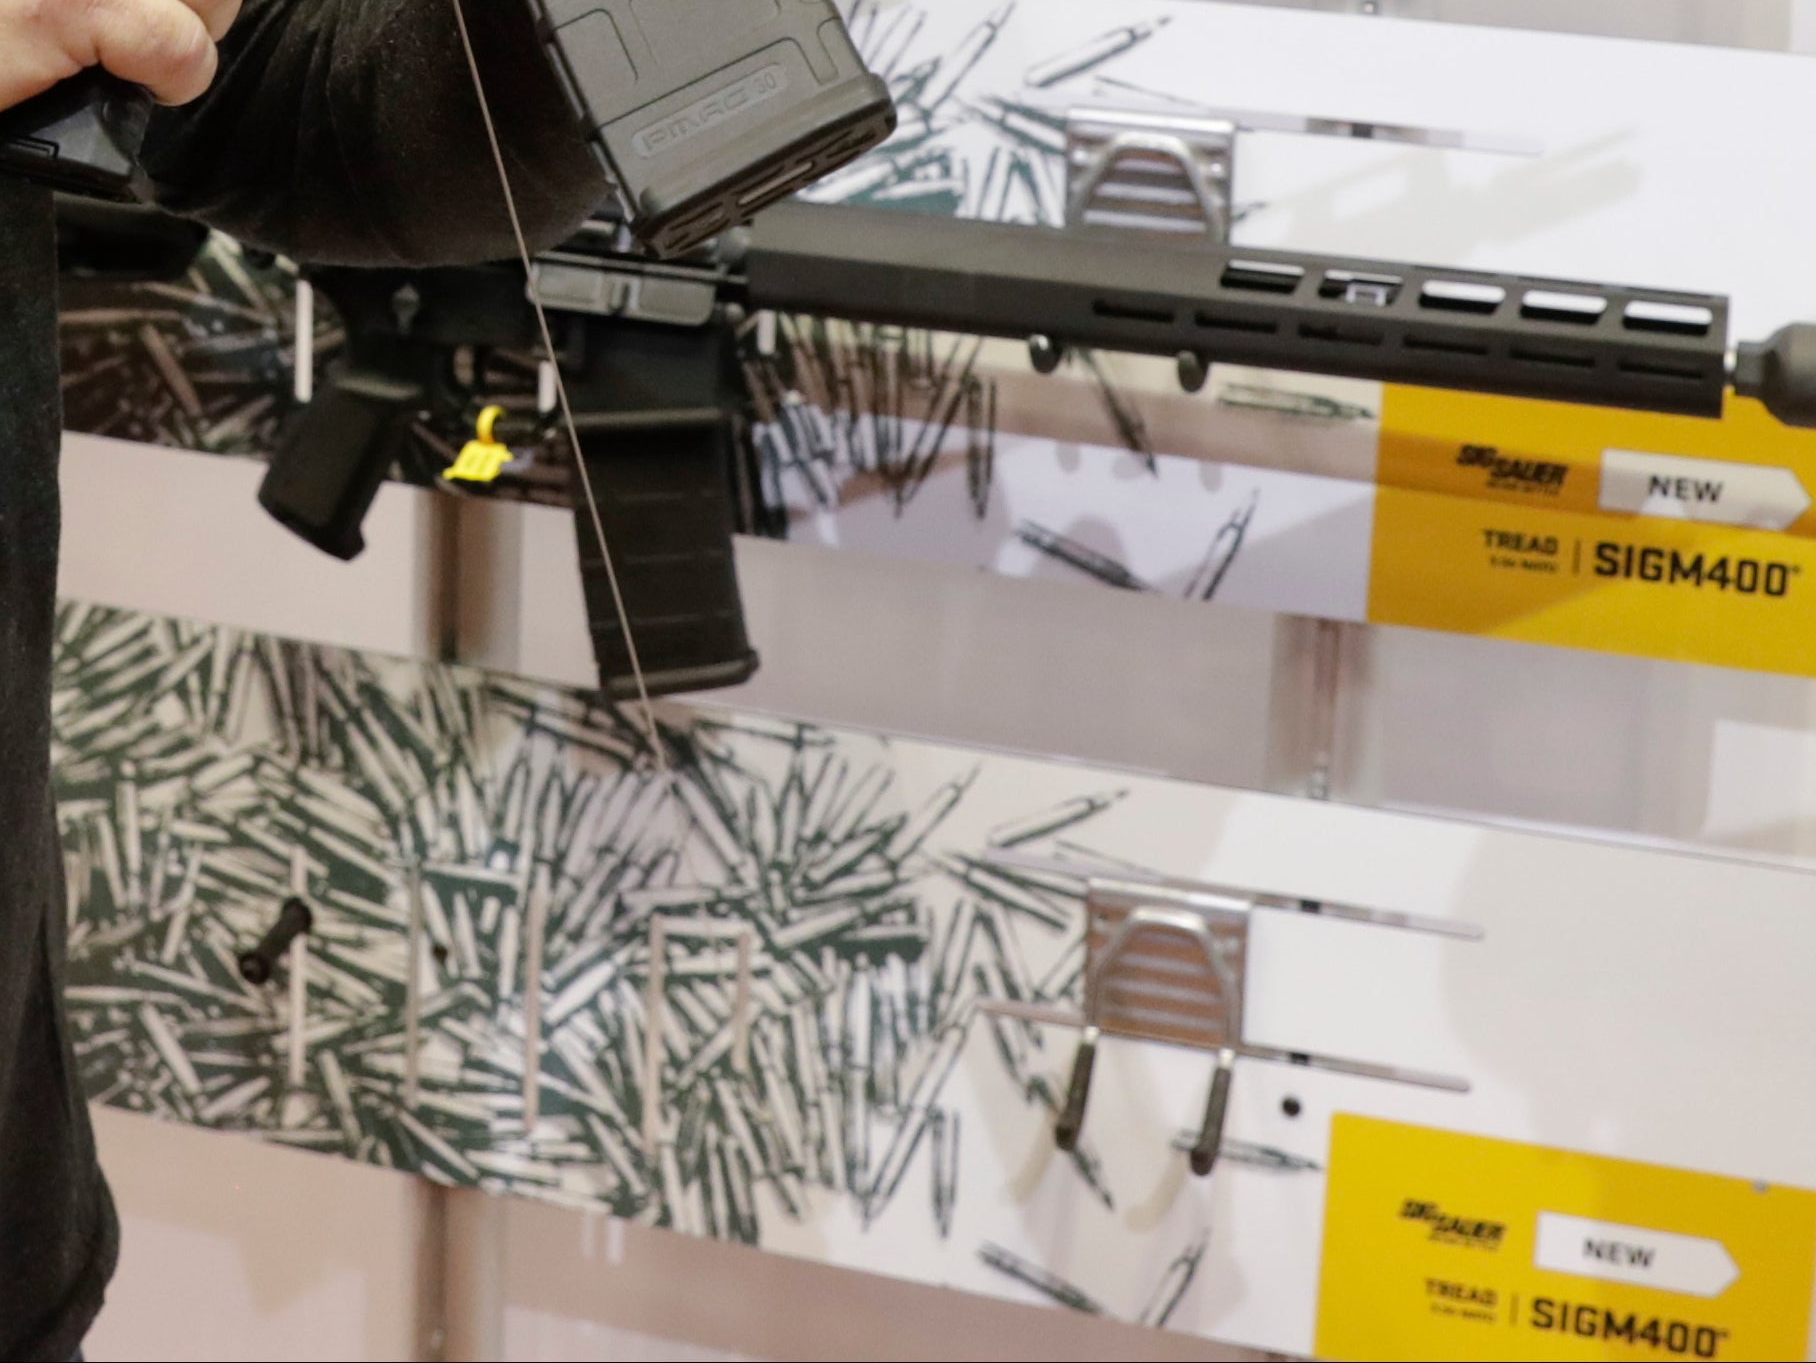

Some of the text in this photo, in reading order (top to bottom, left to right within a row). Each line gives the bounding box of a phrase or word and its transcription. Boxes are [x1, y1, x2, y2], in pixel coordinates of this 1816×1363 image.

[1489, 457, 1569, 486] SAUER
[1649, 474, 1724, 503] NEW
[1483, 528, 1559, 556] TREAD
[1583, 1238, 1656, 1269] NEW
[1424, 1277, 1499, 1307] TREAD
